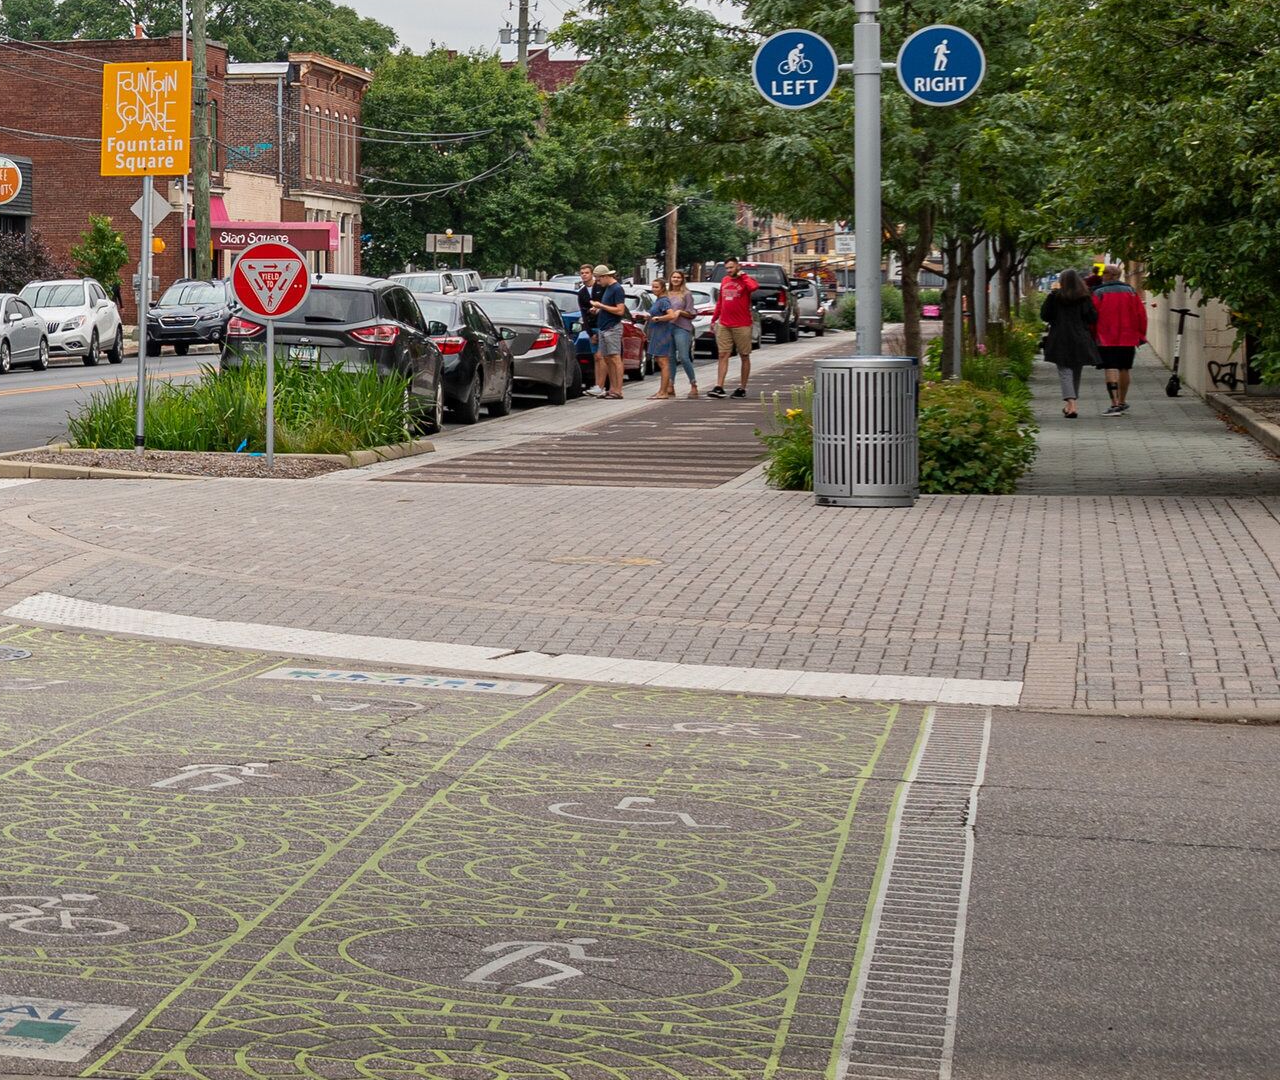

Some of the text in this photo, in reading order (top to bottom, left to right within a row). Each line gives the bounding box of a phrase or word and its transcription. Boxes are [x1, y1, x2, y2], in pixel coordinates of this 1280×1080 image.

[771, 79, 818, 96] LEFT
[914, 76, 968, 92] RIGHT
[107, 135, 183, 152] Fountain
[115, 153, 175, 173] Square
[220, 231, 246, 244] Siam
[261, 272, 280, 281] YIELD
[266, 280, 274, 289] TO
